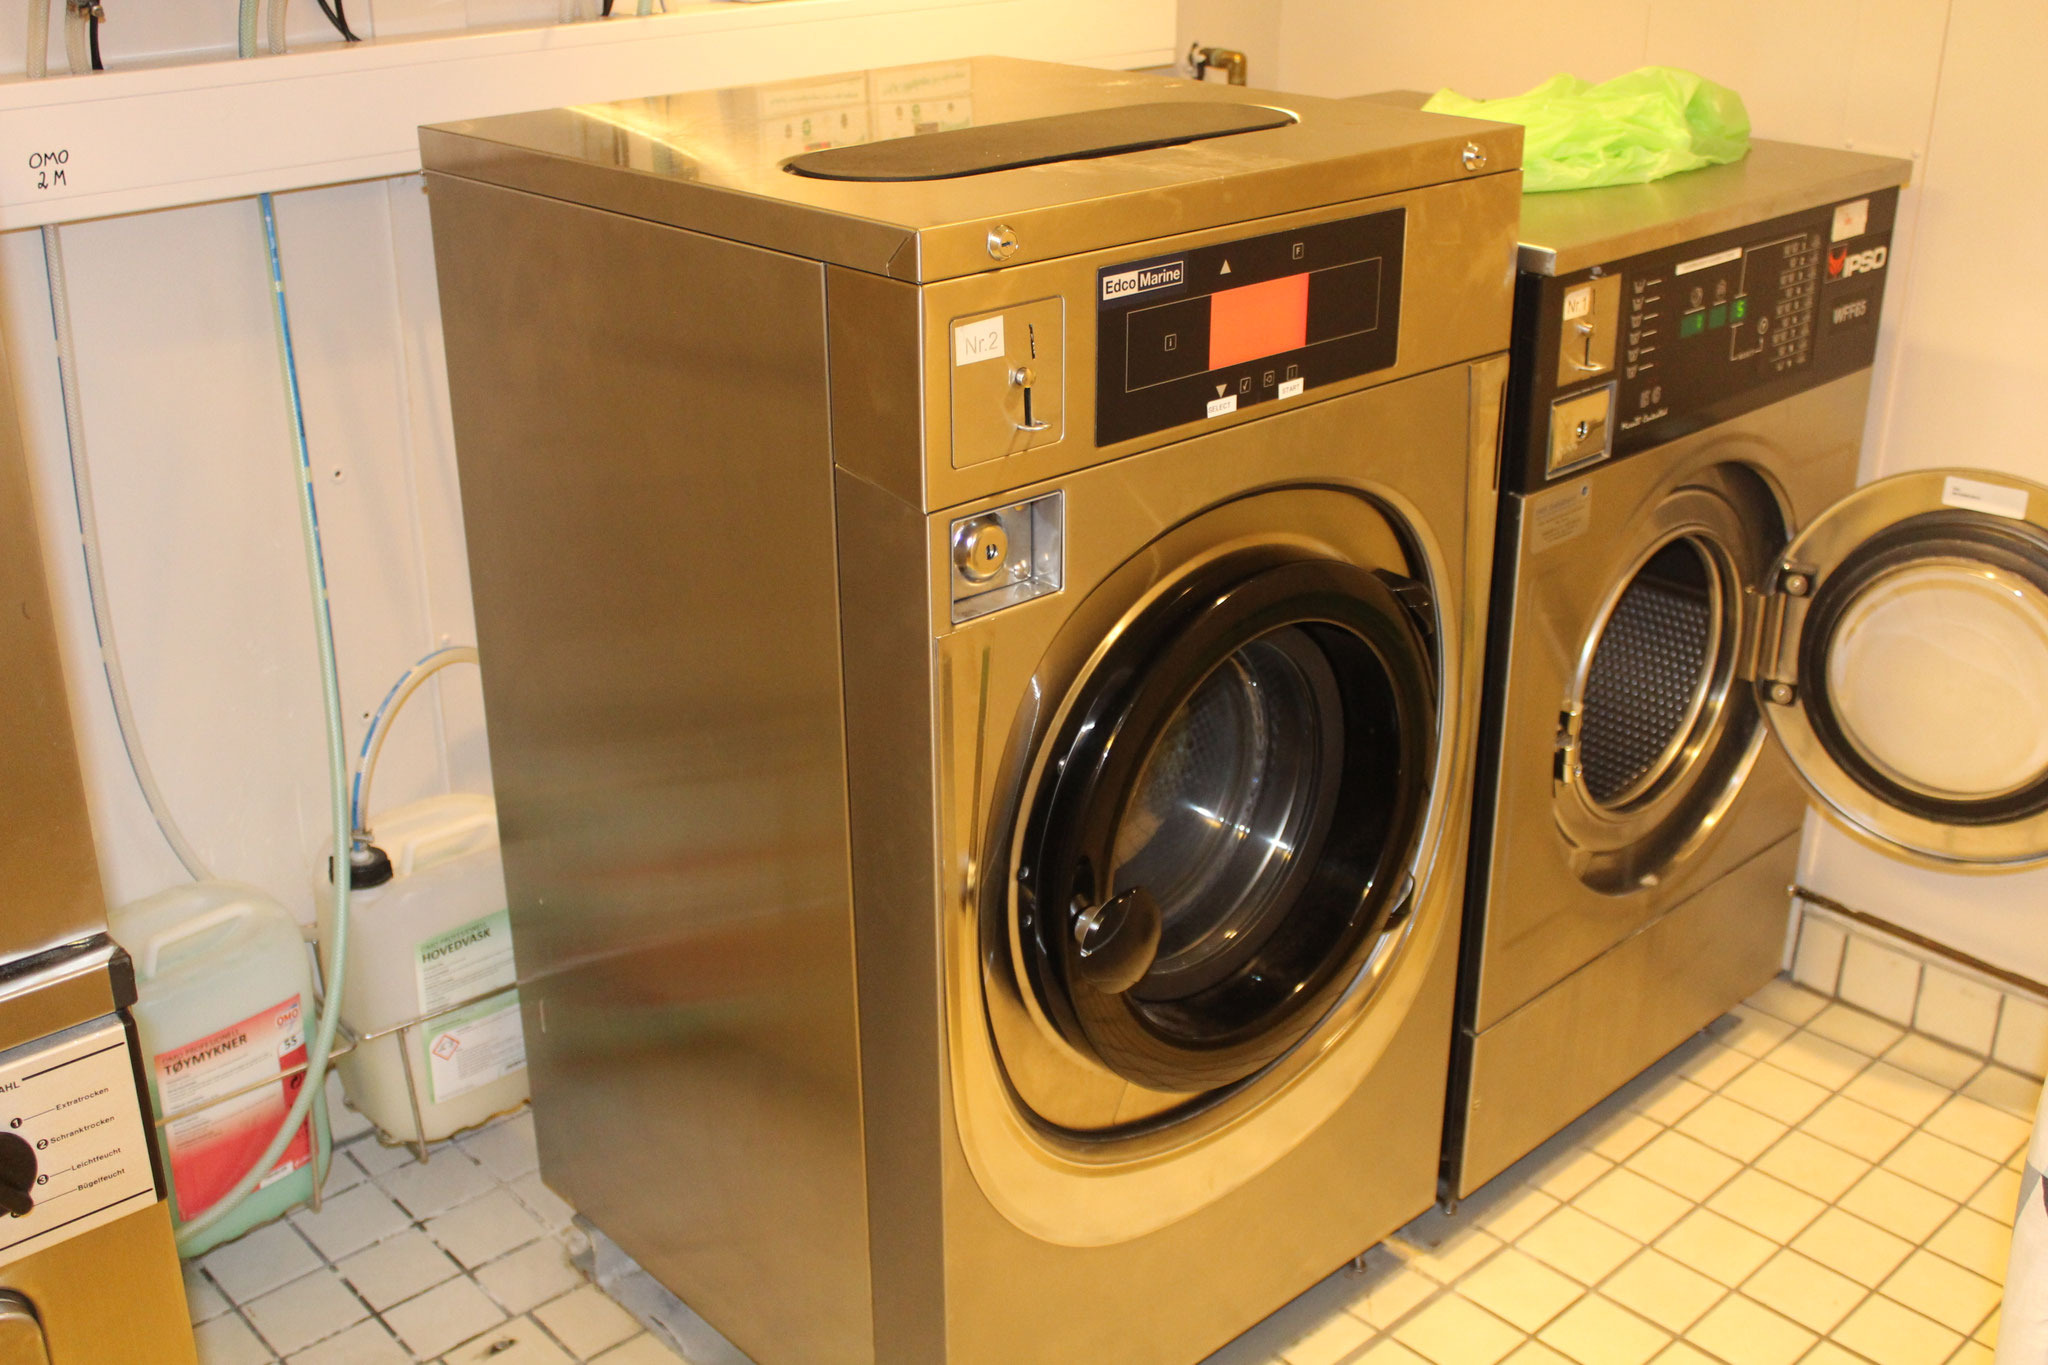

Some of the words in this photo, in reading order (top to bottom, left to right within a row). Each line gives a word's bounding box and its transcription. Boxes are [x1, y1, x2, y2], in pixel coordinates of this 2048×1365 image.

[28, 149, 69, 169] OMO
[37, 171, 49, 190] 2
[53, 169, 67, 186] M
[1842, 245, 1888, 279] IPSO
[1105, 278, 1137, 295] Edco
[1139, 268, 1181, 288] Marine
[965, 331, 999, 356] Nr.2
[1281, 383, 1301, 395] START
[1208, 401, 1232, 414] SELECT
[422, 927, 492, 963] HOVEDVASK
[277, 1008, 298, 1026] OMO
[164, 1034, 248, 1076] TØYMYKNER
[55, 1087, 110, 1111] Extratrocken
[50, 1116, 116, 1144] Schranktrocken
[71, 1148, 122, 1172] Leichtfeucht
[77, 1168, 126, 1192] Bügelfeucht
